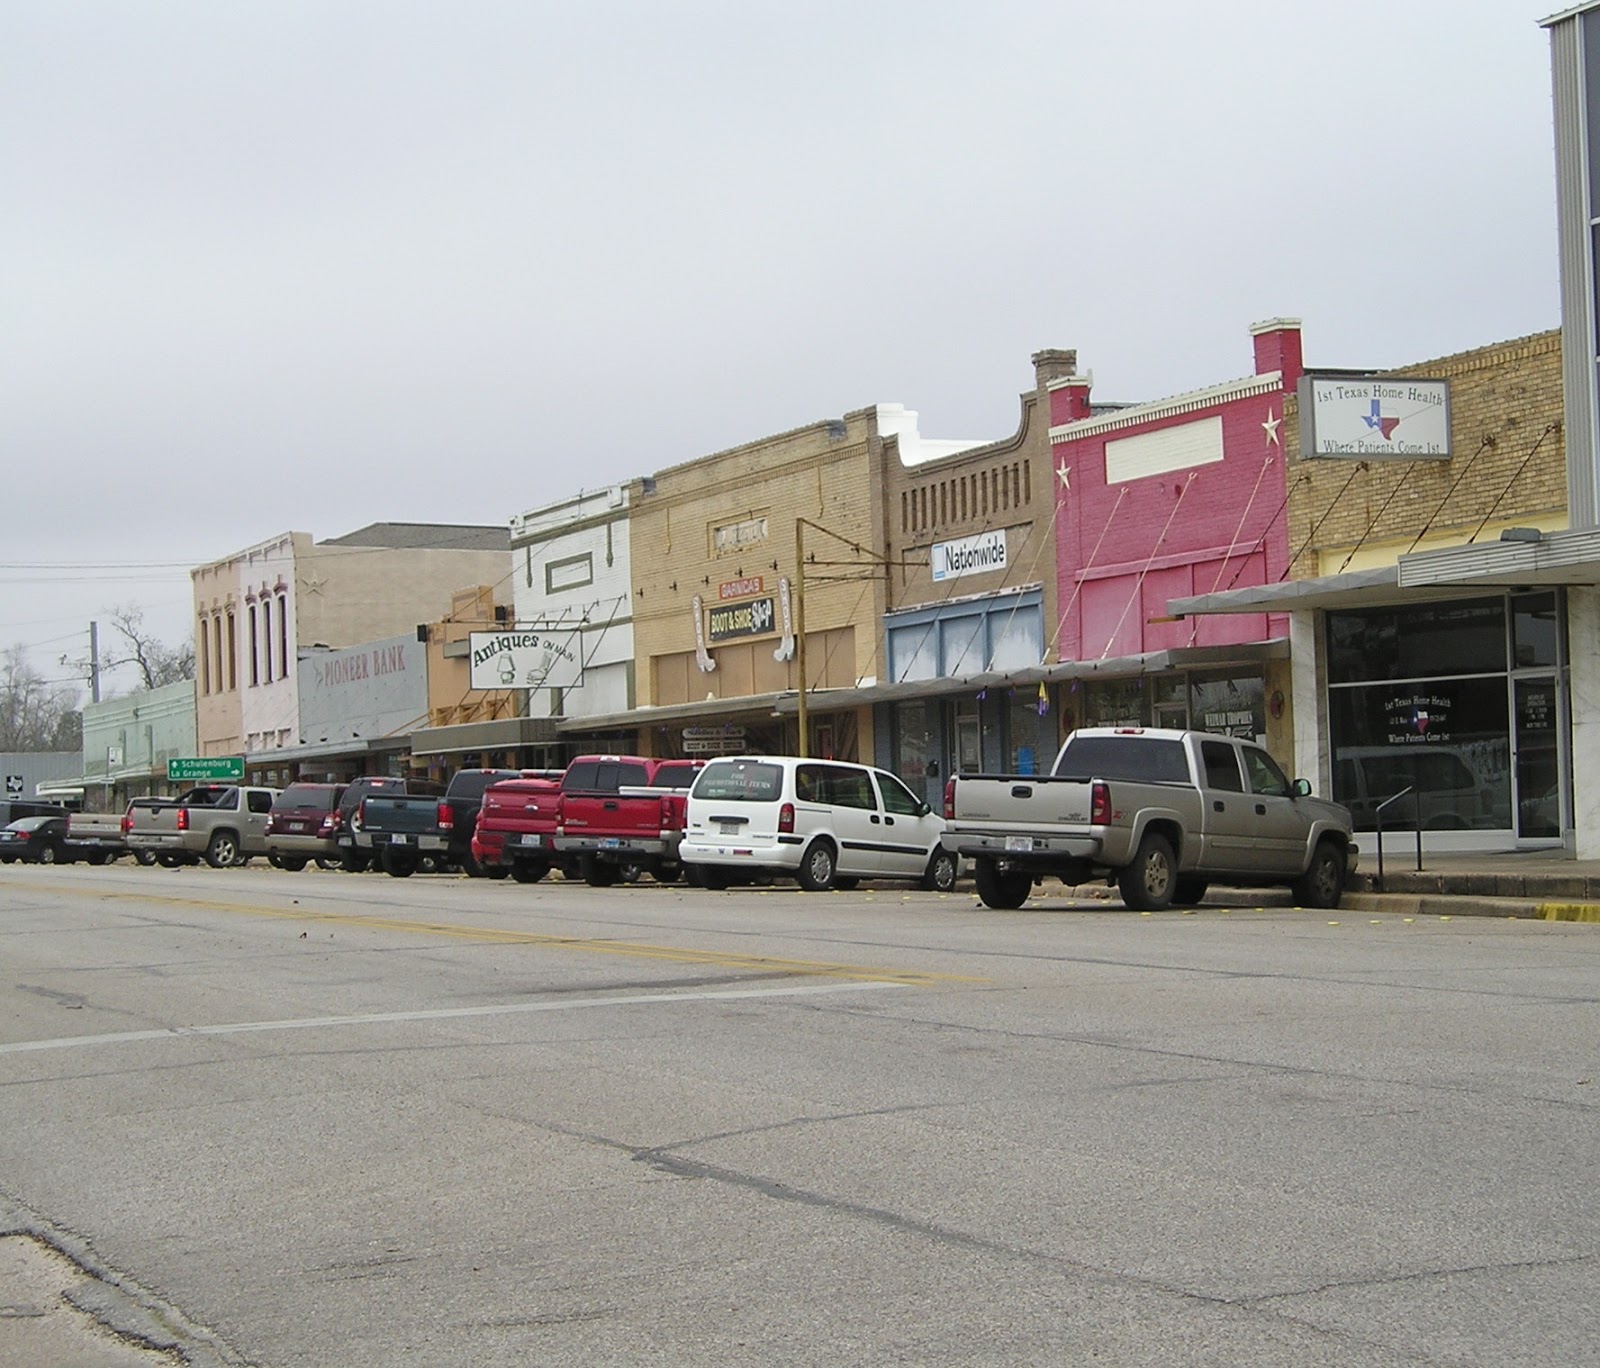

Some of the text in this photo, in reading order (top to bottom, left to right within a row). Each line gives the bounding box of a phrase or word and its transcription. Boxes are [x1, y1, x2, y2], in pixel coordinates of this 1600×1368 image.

[1317, 384, 1443, 406] 1st Texas Home Health
[1323, 440, 1440, 454] Where Patients Come 1st
[945, 535, 1005, 572] Nationwide
[711, 612, 729, 633] BOOT
[728, 611, 735, 630] &
[734, 607, 752, 629] SHOE
[473, 634, 576, 668] Antiques ON MAIN
[324, 644, 406, 687] PIONEER BANK
[181, 760, 231, 768] Schulenburg
[183, 769, 212, 778] Grange
